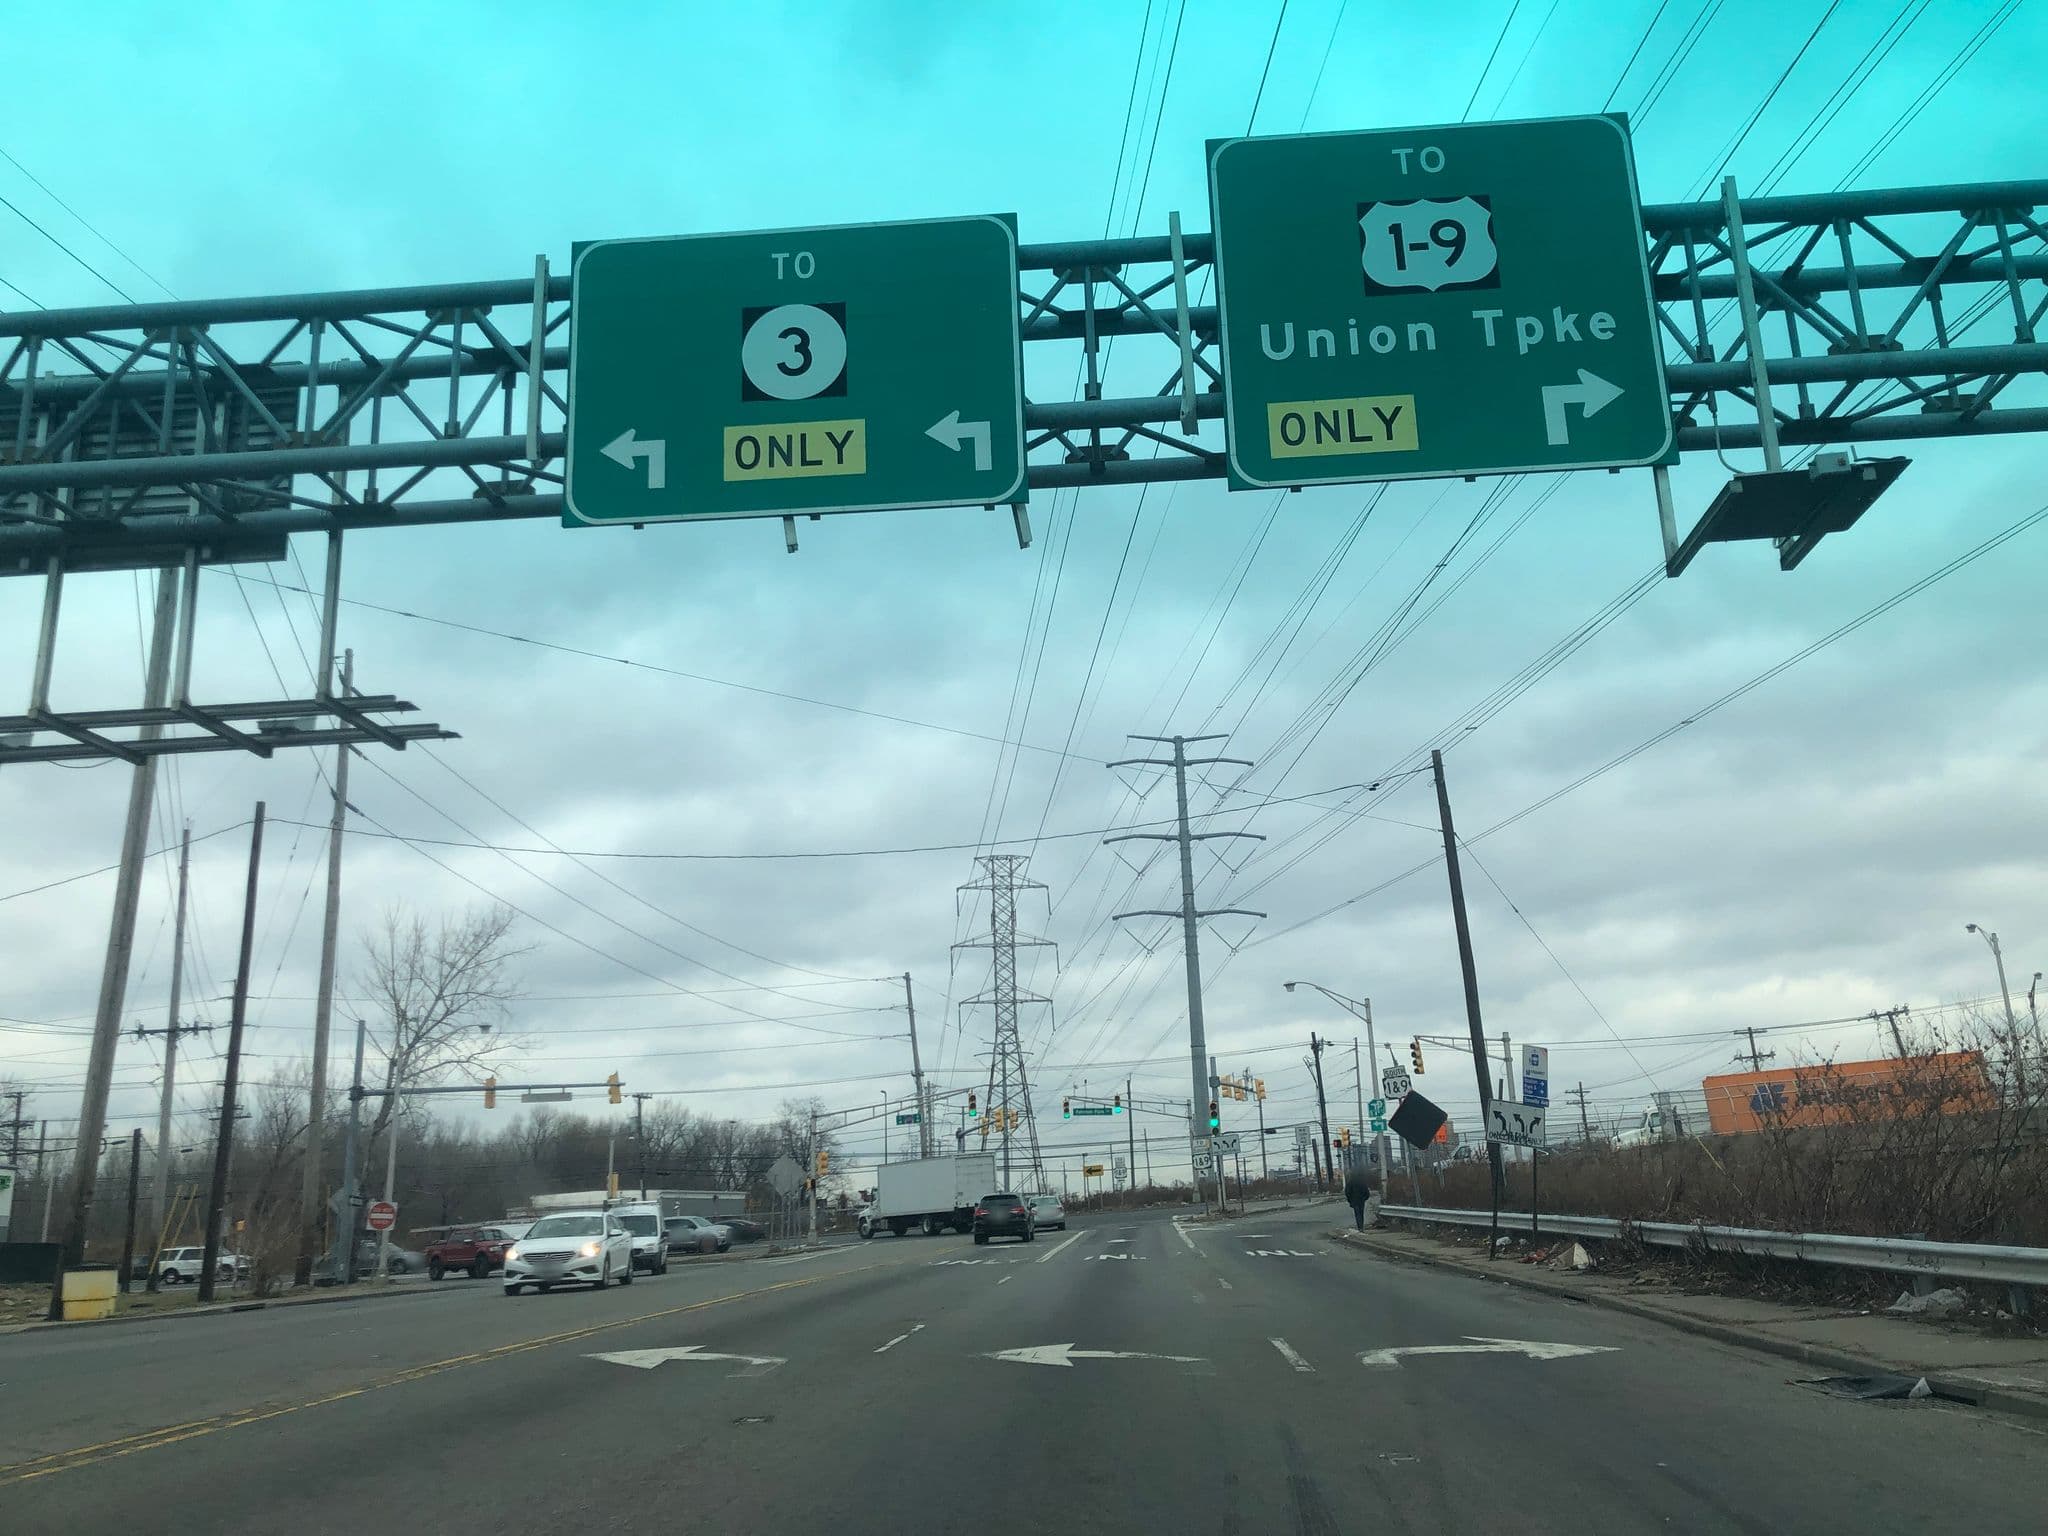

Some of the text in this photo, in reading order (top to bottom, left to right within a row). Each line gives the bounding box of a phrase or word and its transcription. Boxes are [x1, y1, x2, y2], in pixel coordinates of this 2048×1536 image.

[1391, 146, 1446, 175] TO
[771, 251, 816, 280] TO
[1387, 218, 1467, 271] 1-9
[775, 326, 813, 377] 3
[1259, 305, 1617, 361] Union Tpke
[1279, 404, 1404, 447] ONLY
[734, 429, 855, 471] ONLY
[1384, 1067, 1406, 1078] SOUTH
[1386, 1079, 1408, 1095] 1&9
